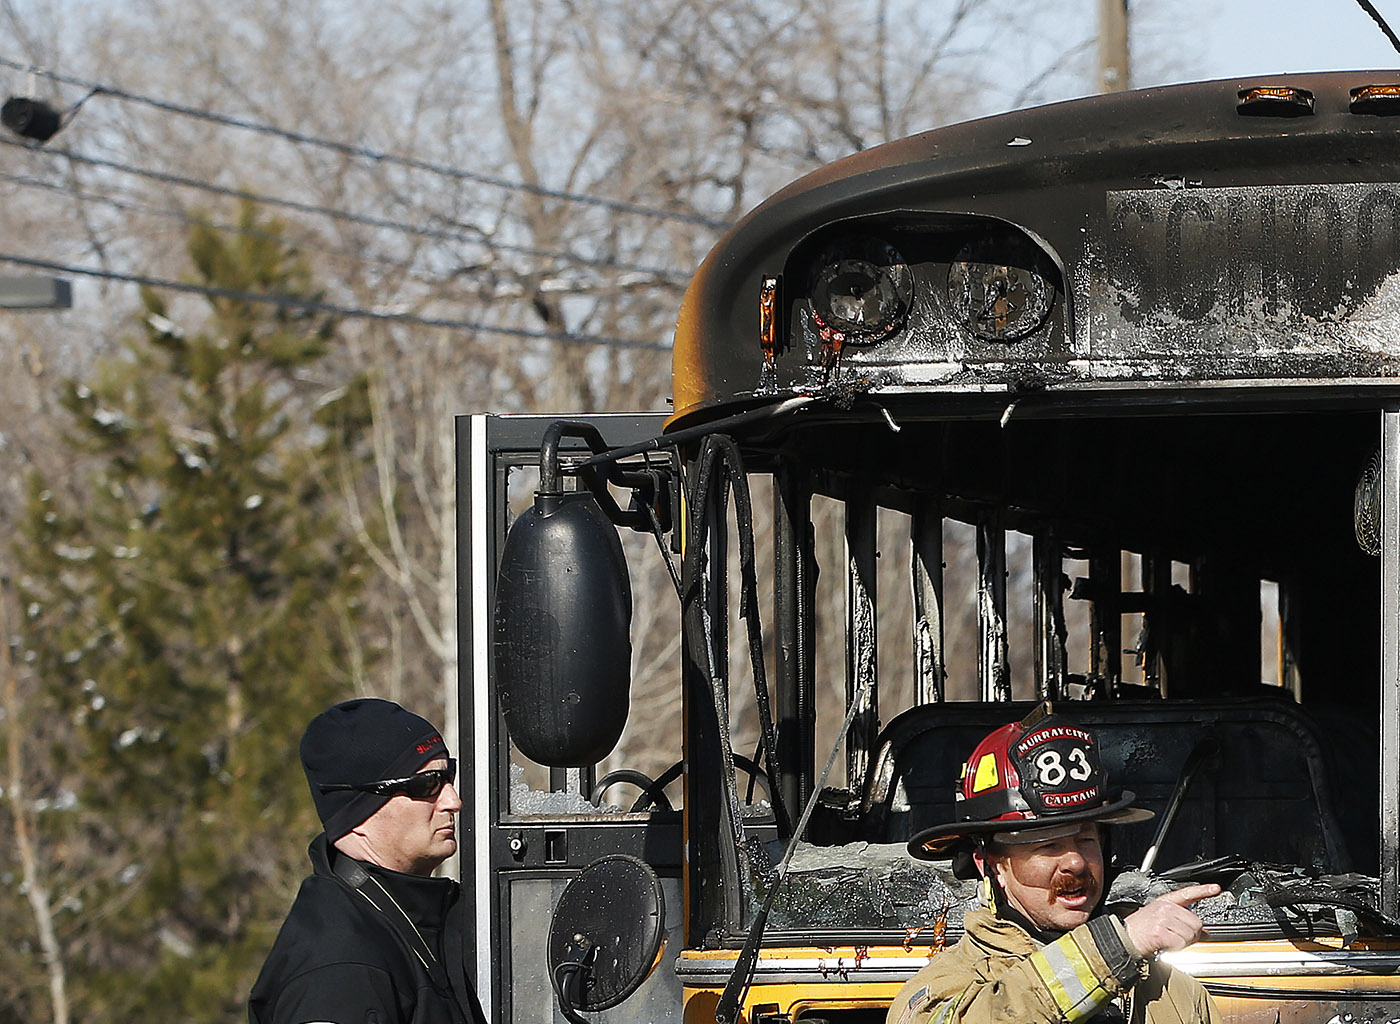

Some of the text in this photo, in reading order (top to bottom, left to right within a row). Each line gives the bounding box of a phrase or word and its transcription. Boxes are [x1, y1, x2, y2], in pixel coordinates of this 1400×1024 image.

[1018, 727, 1090, 753] MURRAY CITY
[1036, 747, 1092, 786] 83
[1045, 789, 1096, 804] CAPTAIN
